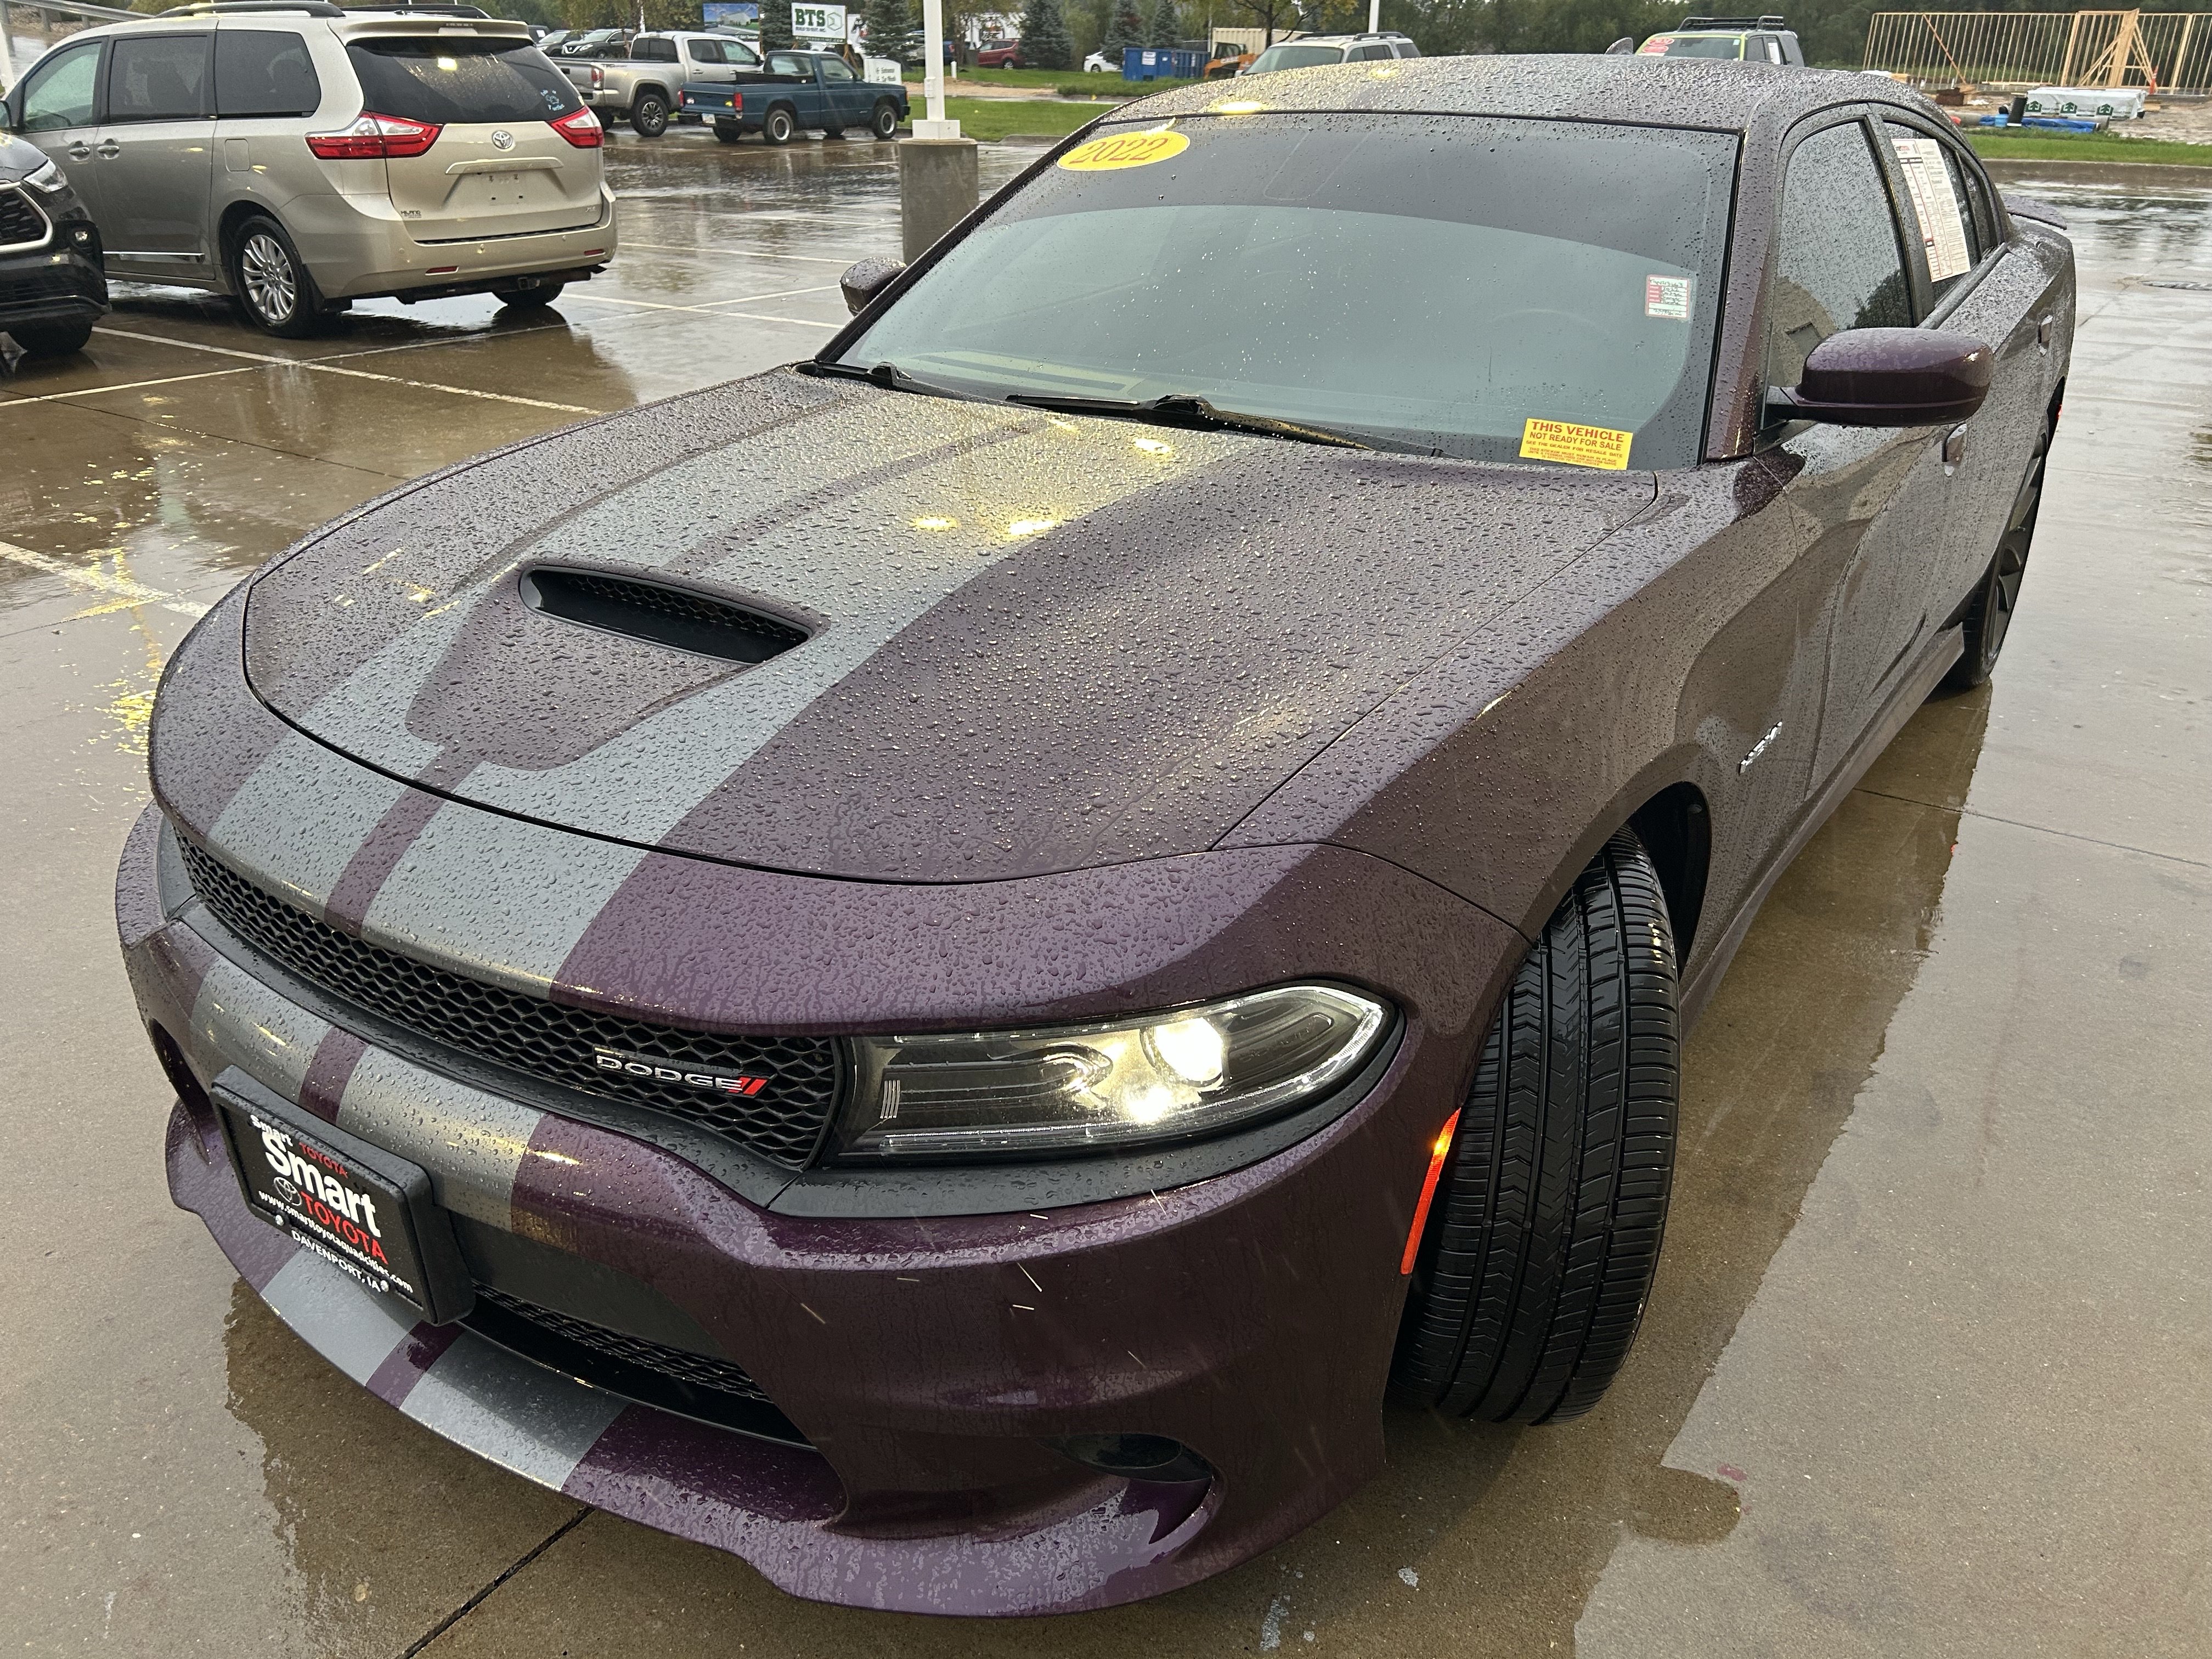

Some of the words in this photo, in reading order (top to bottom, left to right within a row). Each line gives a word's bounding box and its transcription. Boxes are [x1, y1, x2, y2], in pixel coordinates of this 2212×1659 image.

[795, 8, 825, 26] BTS
[1069, 138, 1168, 164] 2022
[1532, 421, 1562, 433] THIS
[1567, 426, 1624, 442] VEHICLE
[1549, 434, 1578, 444] READY
[1580, 438, 1597, 447] FOR
[1599, 441, 1621, 450] SALE
[596, 1054, 742, 1091] DODGE
[250, 1114, 294, 1147] Smart
[298, 1142, 348, 1178] TOYOTA
[262, 1130, 381, 1237] Smart
[259, 1190, 413, 1293] www.smarttoyotaquadcities.com
[300, 1191, 388, 1264] TOYOTA
[291, 1230, 365, 1283] DAVENPORT,
[367, 1277, 381, 1292] IA
